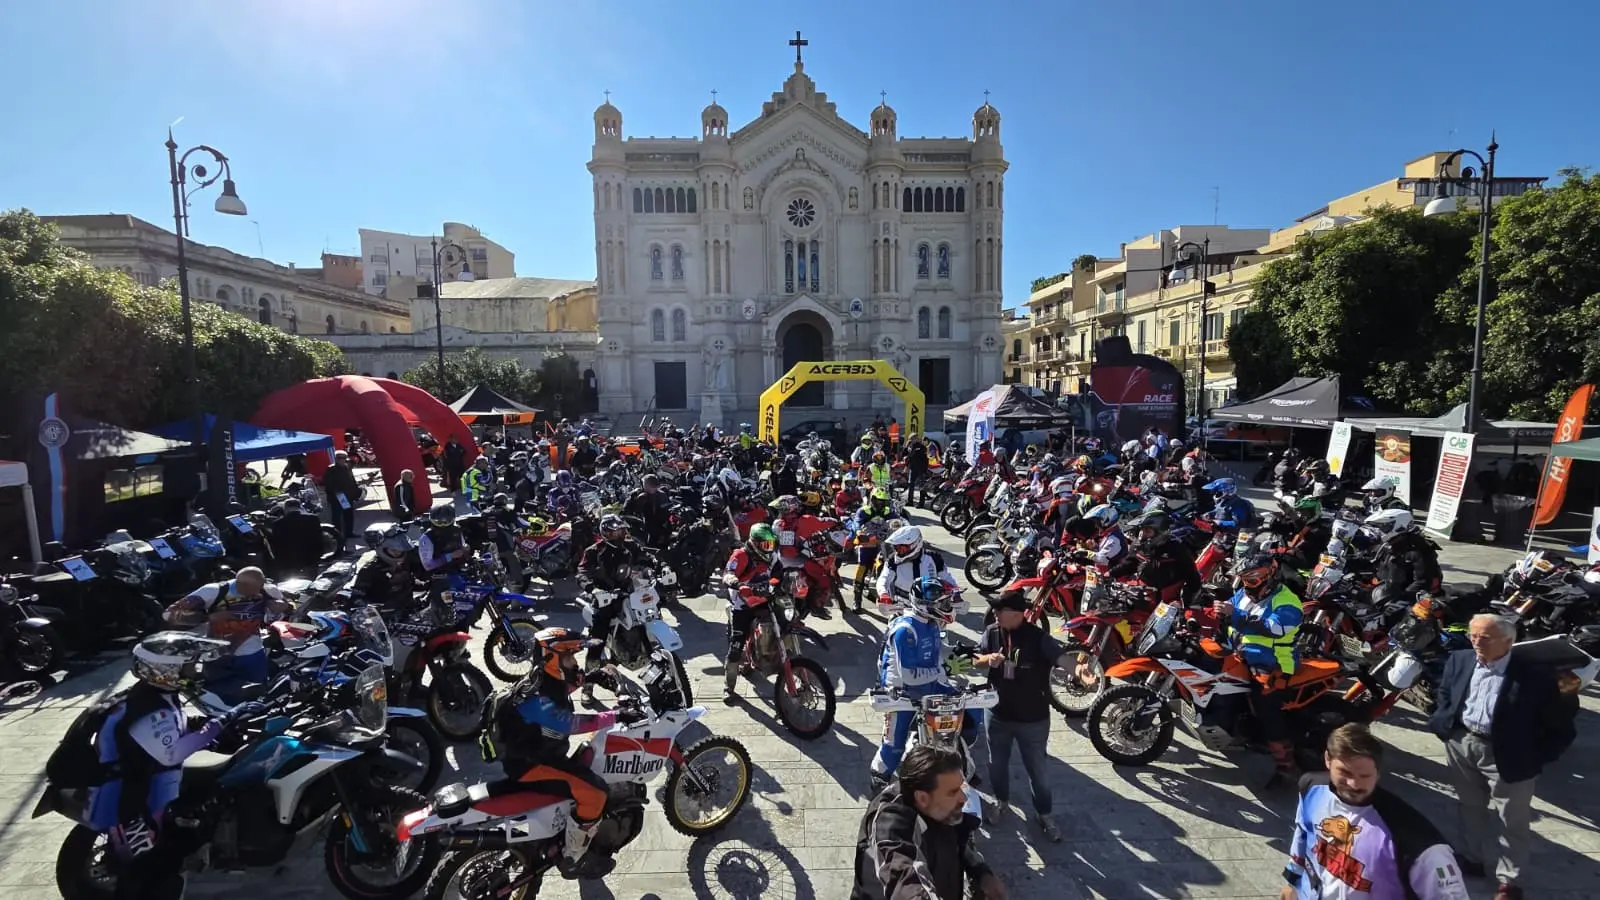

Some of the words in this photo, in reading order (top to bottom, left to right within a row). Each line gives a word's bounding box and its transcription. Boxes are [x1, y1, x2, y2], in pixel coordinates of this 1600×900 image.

[809, 364, 876, 375] ACERBIS
[1143, 394, 1173, 402] RACE
[224, 430, 237, 503] ORBIDELLI
[602, 754, 664, 775] Marlboro
